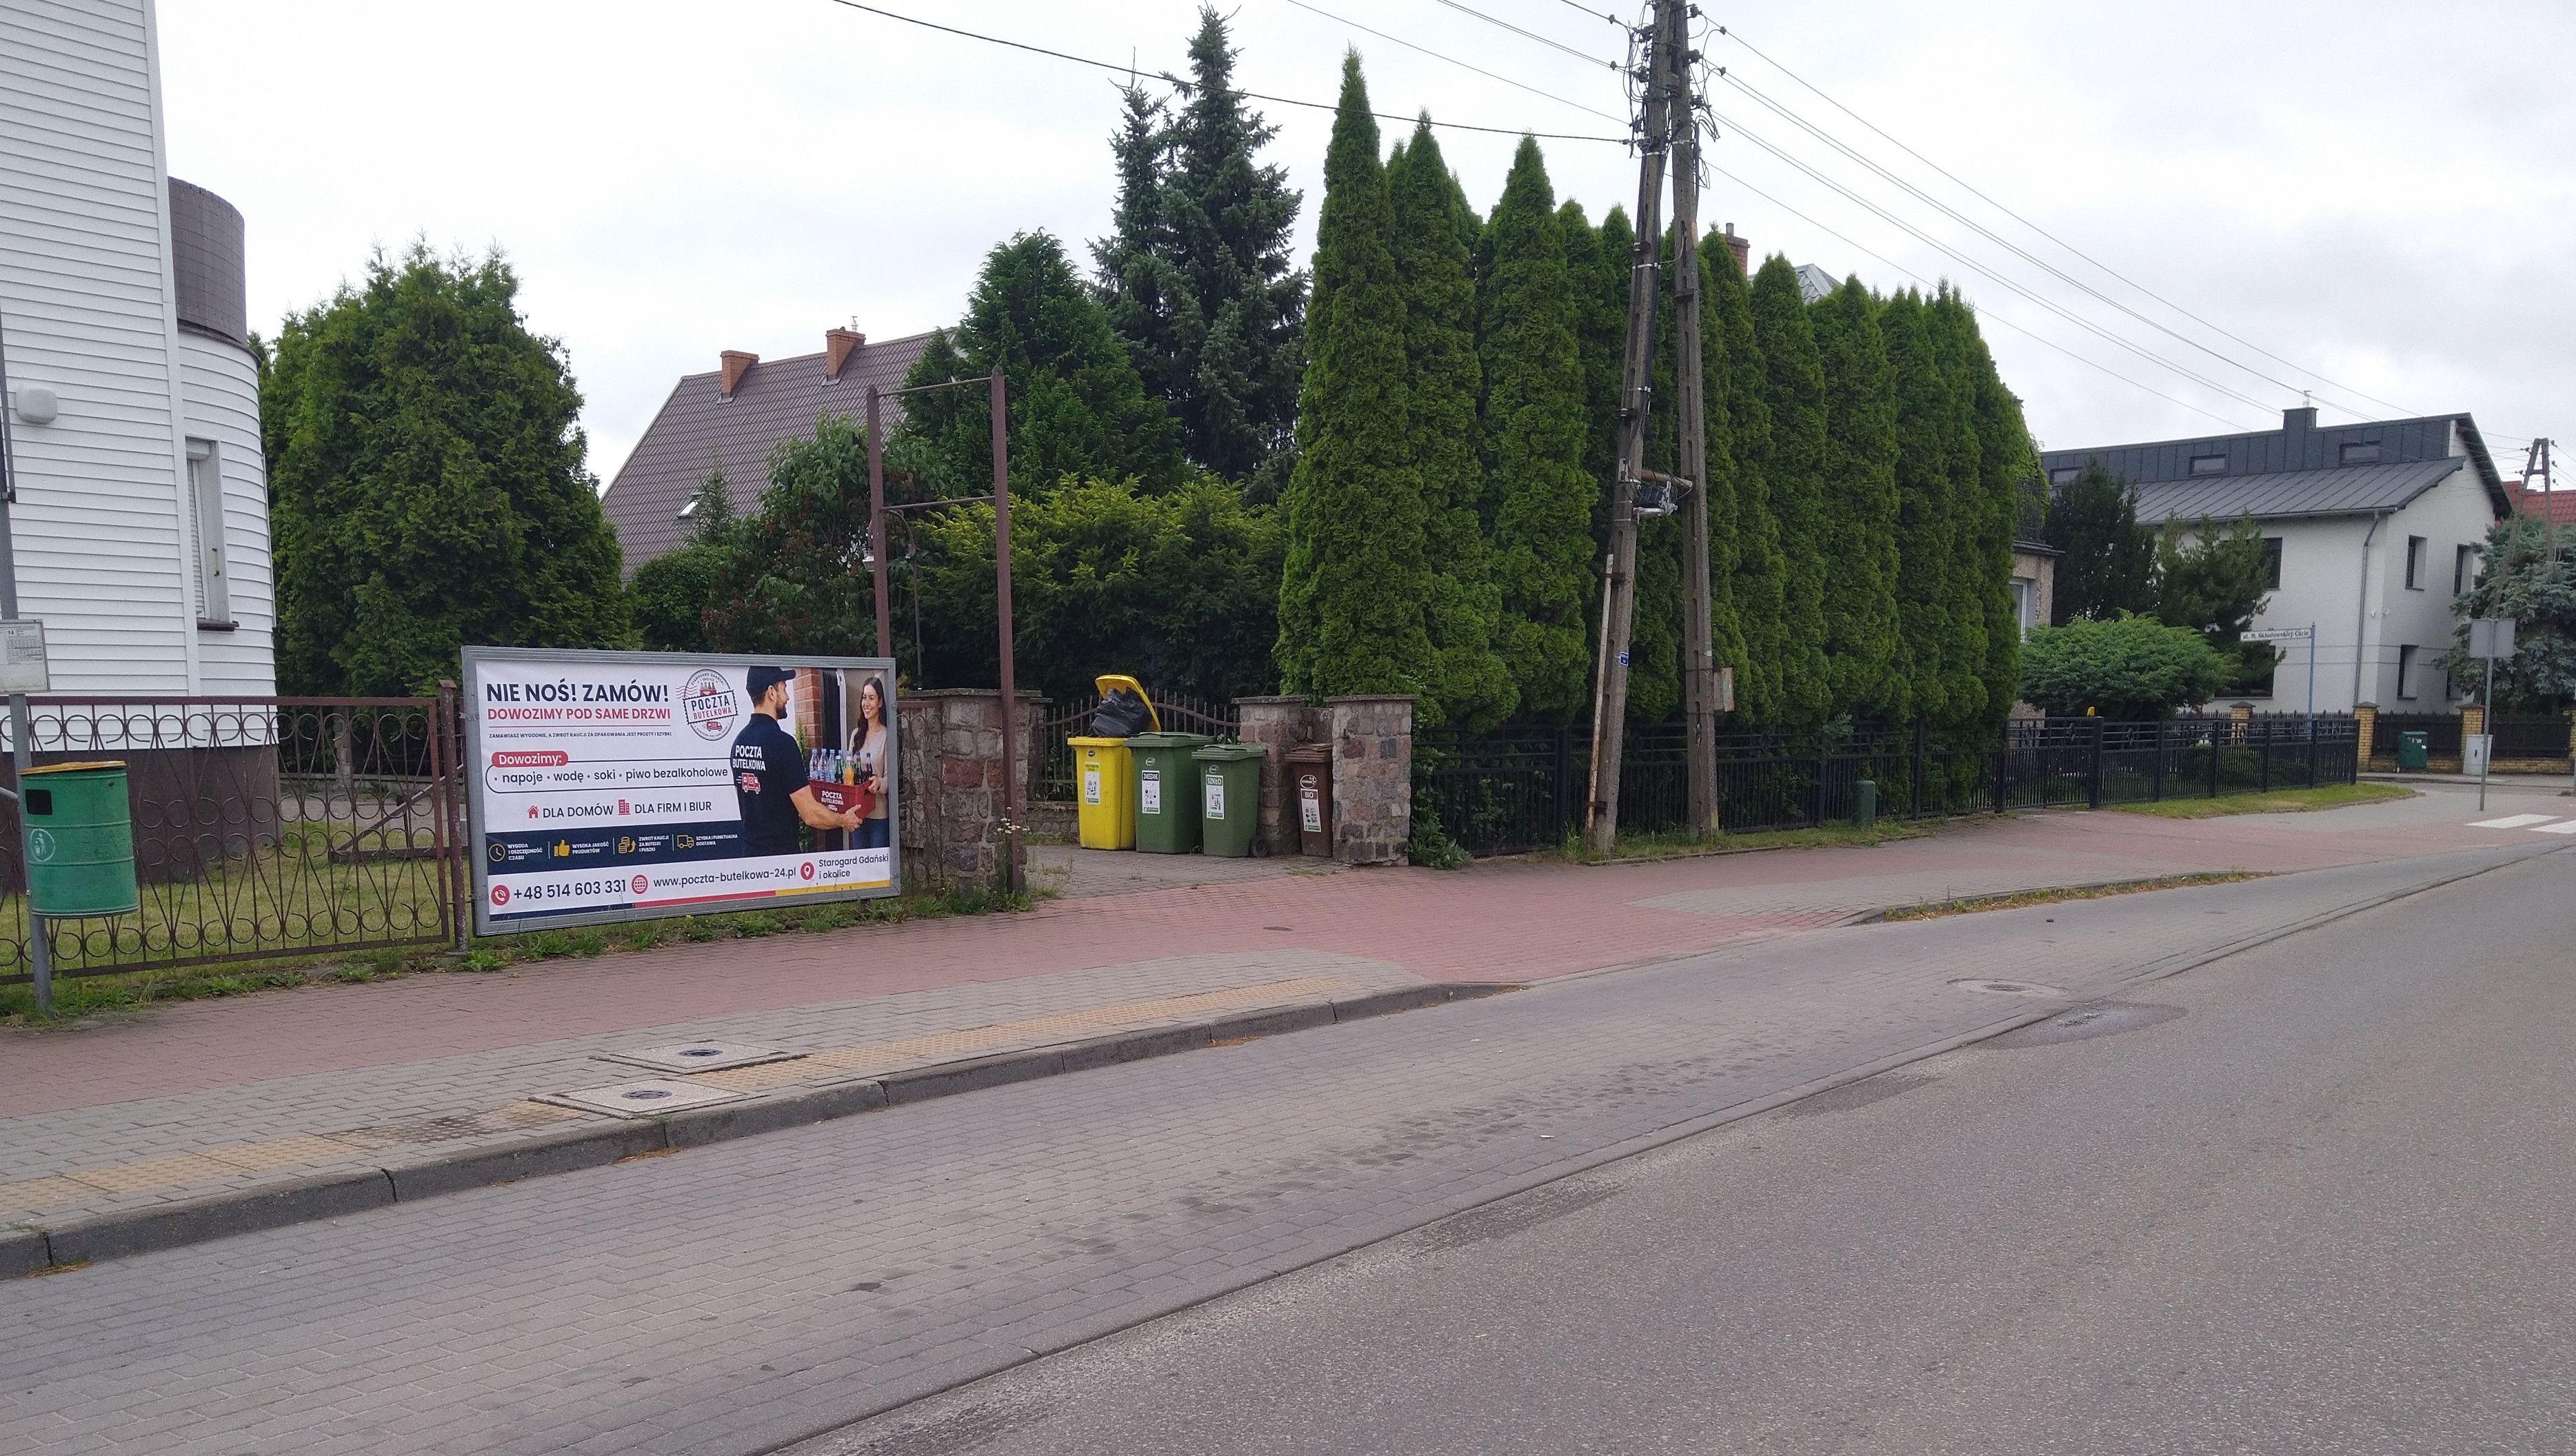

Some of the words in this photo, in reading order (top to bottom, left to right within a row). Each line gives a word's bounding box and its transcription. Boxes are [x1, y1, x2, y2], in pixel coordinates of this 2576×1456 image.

[486, 683, 520, 702] NIE
[525, 678, 577, 702] NOŚ!
[583, 679, 669, 702] ZAMÓW!
[691, 694, 730, 711] POCZTA
[487, 708, 563, 720] DOWOZIMY
[566, 708, 592, 720] POD
[595, 708, 629, 720] SAME
[632, 708, 671, 719] DRZWI
[693, 707, 732, 720] BUTELKOWA
[735, 745, 763, 759] POCZTA
[499, 753, 562, 767] Dowozimy:
[732, 758, 766, 771] BUTELKOWA
[503, 771, 543, 785] napoje
[553, 770, 584, 783] wodę
[594, 769, 616, 780] soki
[626, 769, 651, 782] piwo
[653, 767, 728, 778] bezalkoholowe
[821, 790, 843, 800] POCZTA
[543, 807, 564, 818] DLA
[567, 803, 614, 817] DOMÓW
[634, 803, 654, 814] DLA
[657, 802, 681, 813] FIRM
[684, 802, 687, 811] I
[690, 801, 712, 811] BIUR
[818, 856, 858, 868] Starogard
[858, 853, 889, 865] Gdański
[654, 867, 796, 888] www.poczta-butelkowa-24.pl
[818, 871, 821, 880] i
[823, 869, 850, 880] okolice
[513, 885, 543, 900] +48
[547, 883, 571, 898] 514
[575, 881, 601, 896] 603
[605, 879, 626, 893] 331
